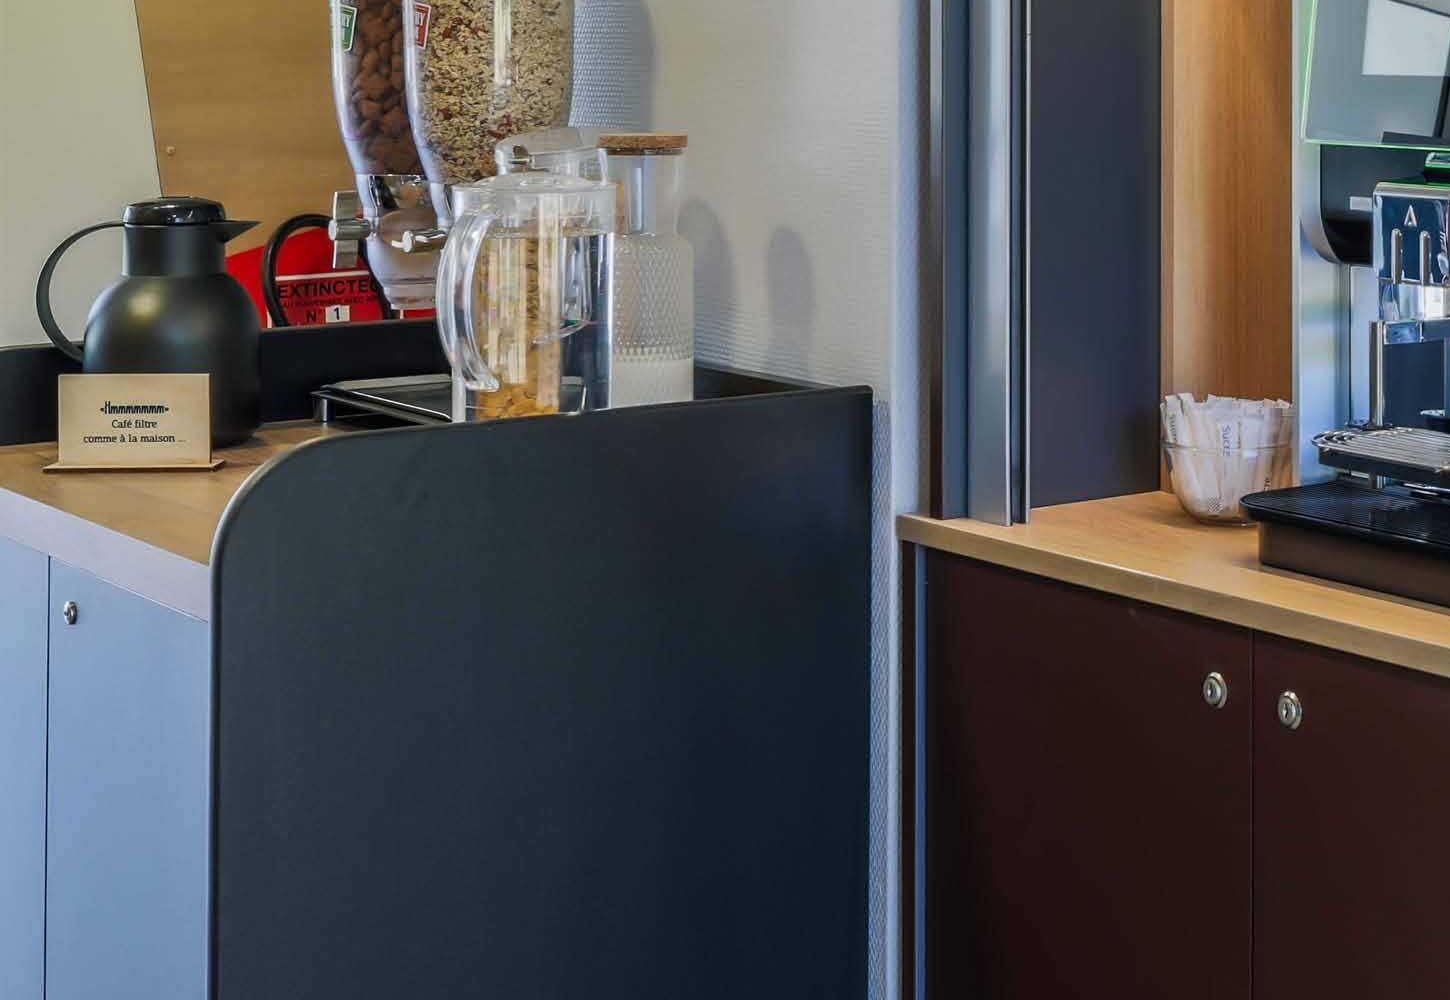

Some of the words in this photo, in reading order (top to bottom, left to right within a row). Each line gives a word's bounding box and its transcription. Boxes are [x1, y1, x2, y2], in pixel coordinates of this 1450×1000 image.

[332, 306, 341, 321] 1
[111, 419, 132, 429] Café
[134, 419, 158, 429] filtre
[83, 435, 117, 444] comme
[119, 433, 126, 443] à
[128, 434, 138, 443] la
[140, 434, 176, 443] maison
